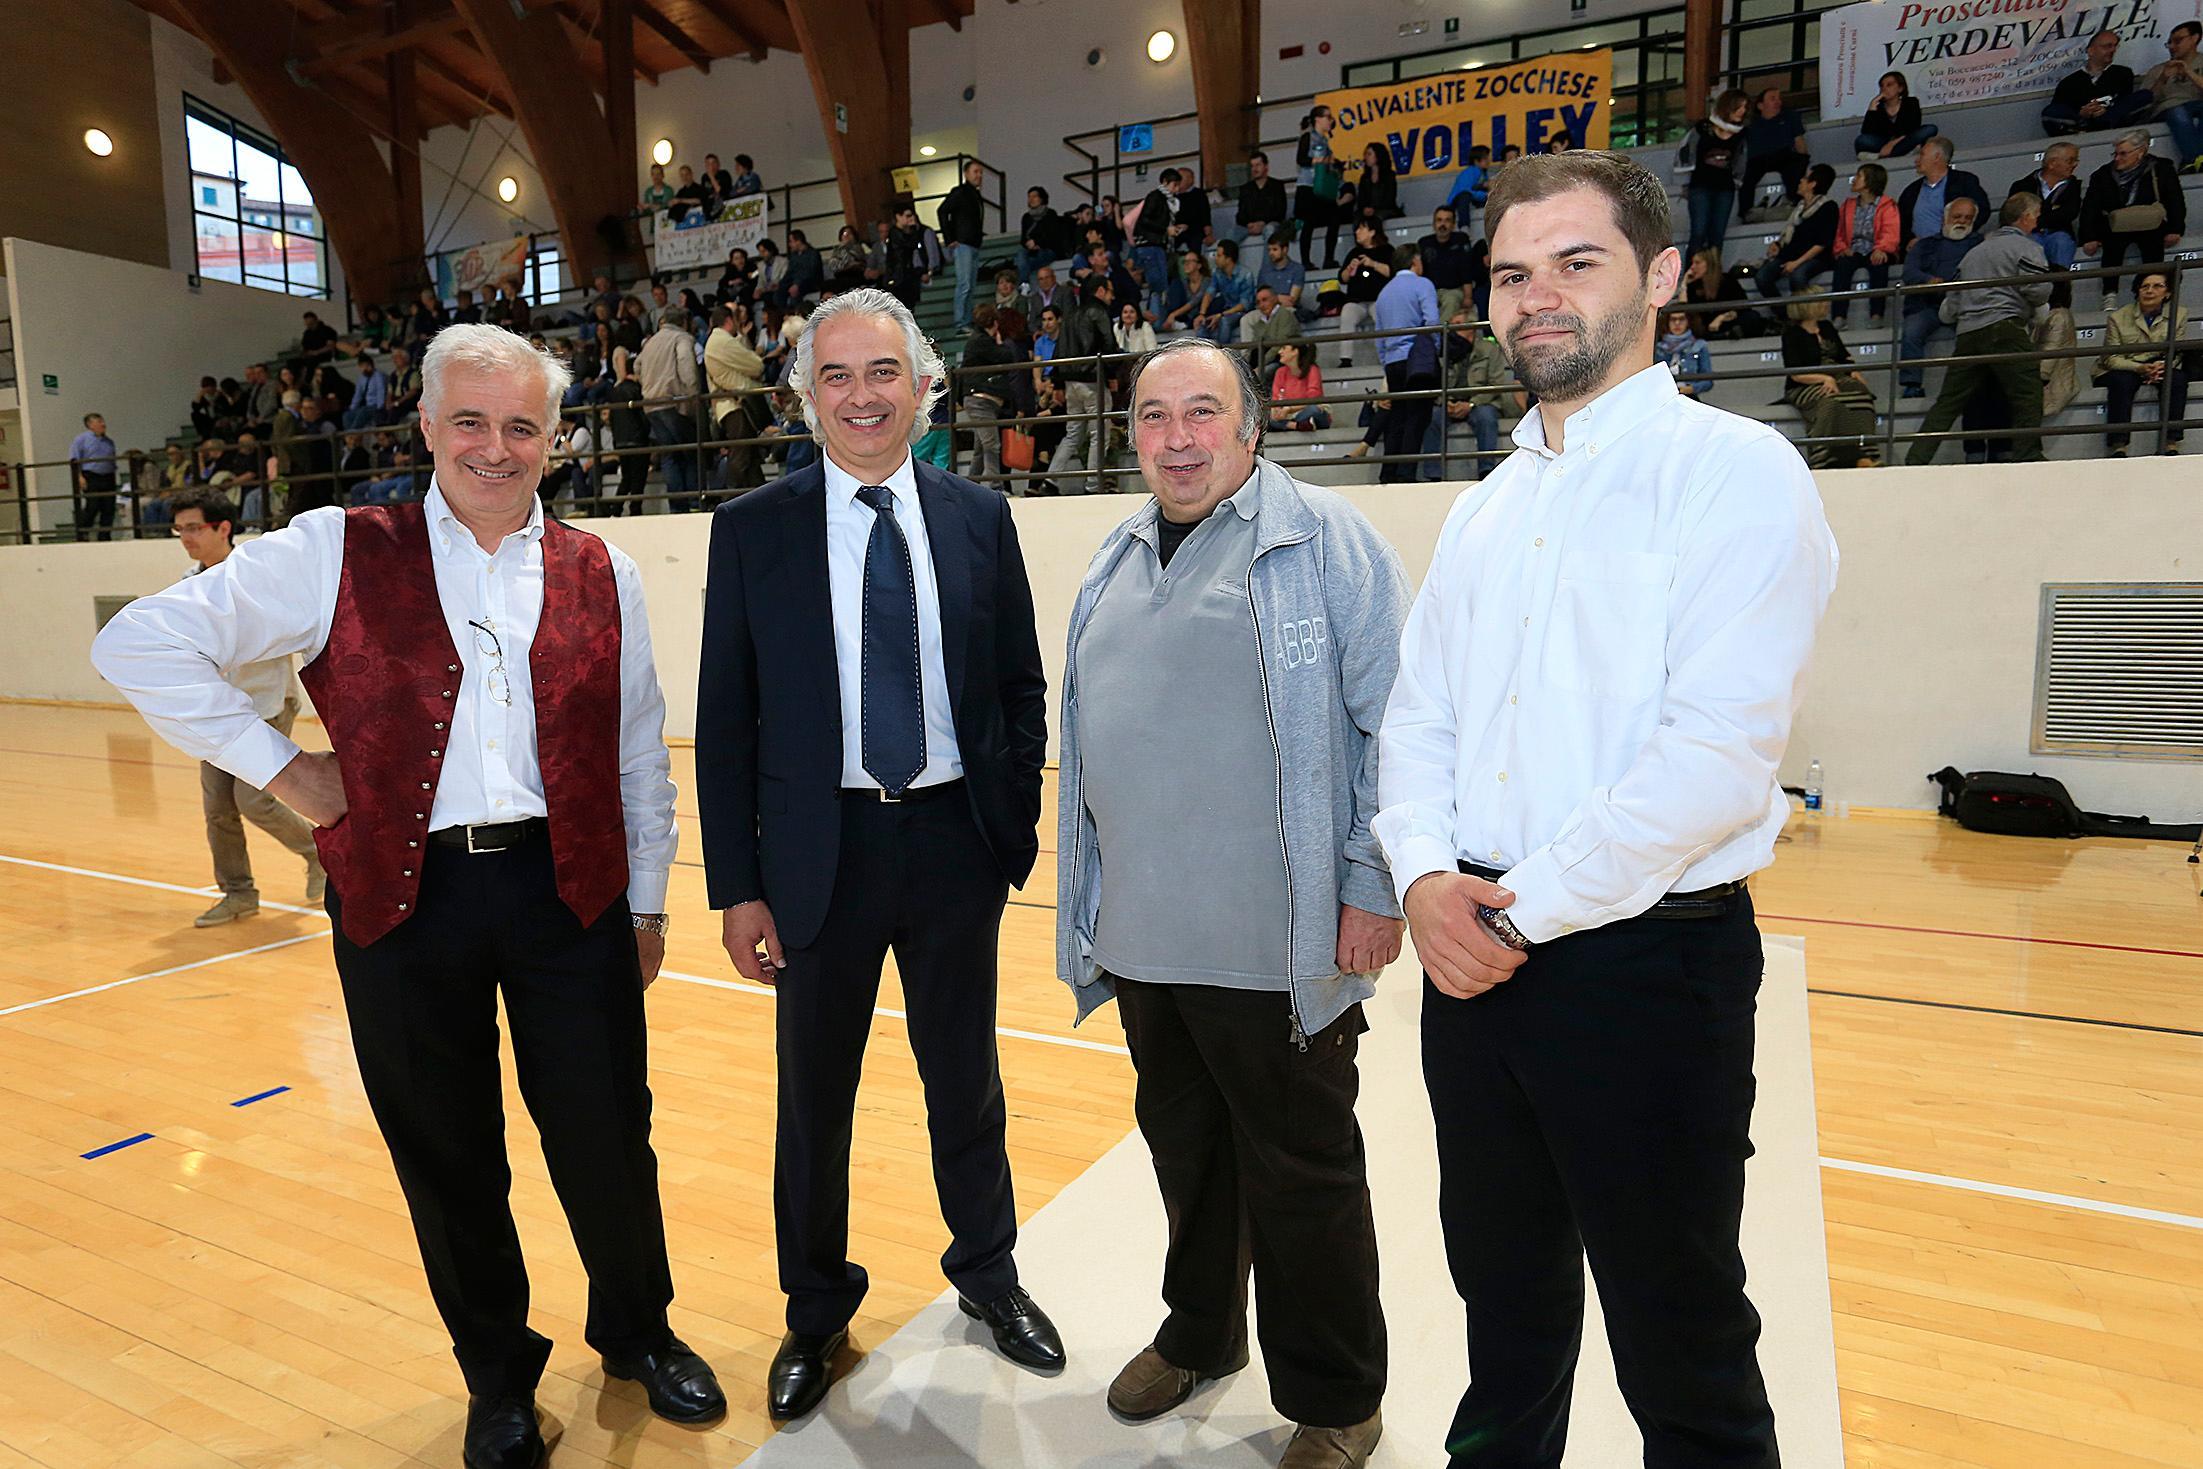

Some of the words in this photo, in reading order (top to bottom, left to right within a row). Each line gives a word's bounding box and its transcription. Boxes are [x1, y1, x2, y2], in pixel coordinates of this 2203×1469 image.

[1882, 0, 2154, 67] VERDEVALLE
[1928, 80, 1943, 89] Tel.
[2017, 68, 2034, 78] Fax
[1929, 68, 1944, 78] Via
[2029, 49, 2069, 63] ZOCCA
[1474, 68, 1598, 99] ZOCCHESE
[1338, 80, 1466, 131] OLIVALENTE
[1387, 101, 1598, 176] VOLLEY
[2080, 330, 2094, 338] 15
